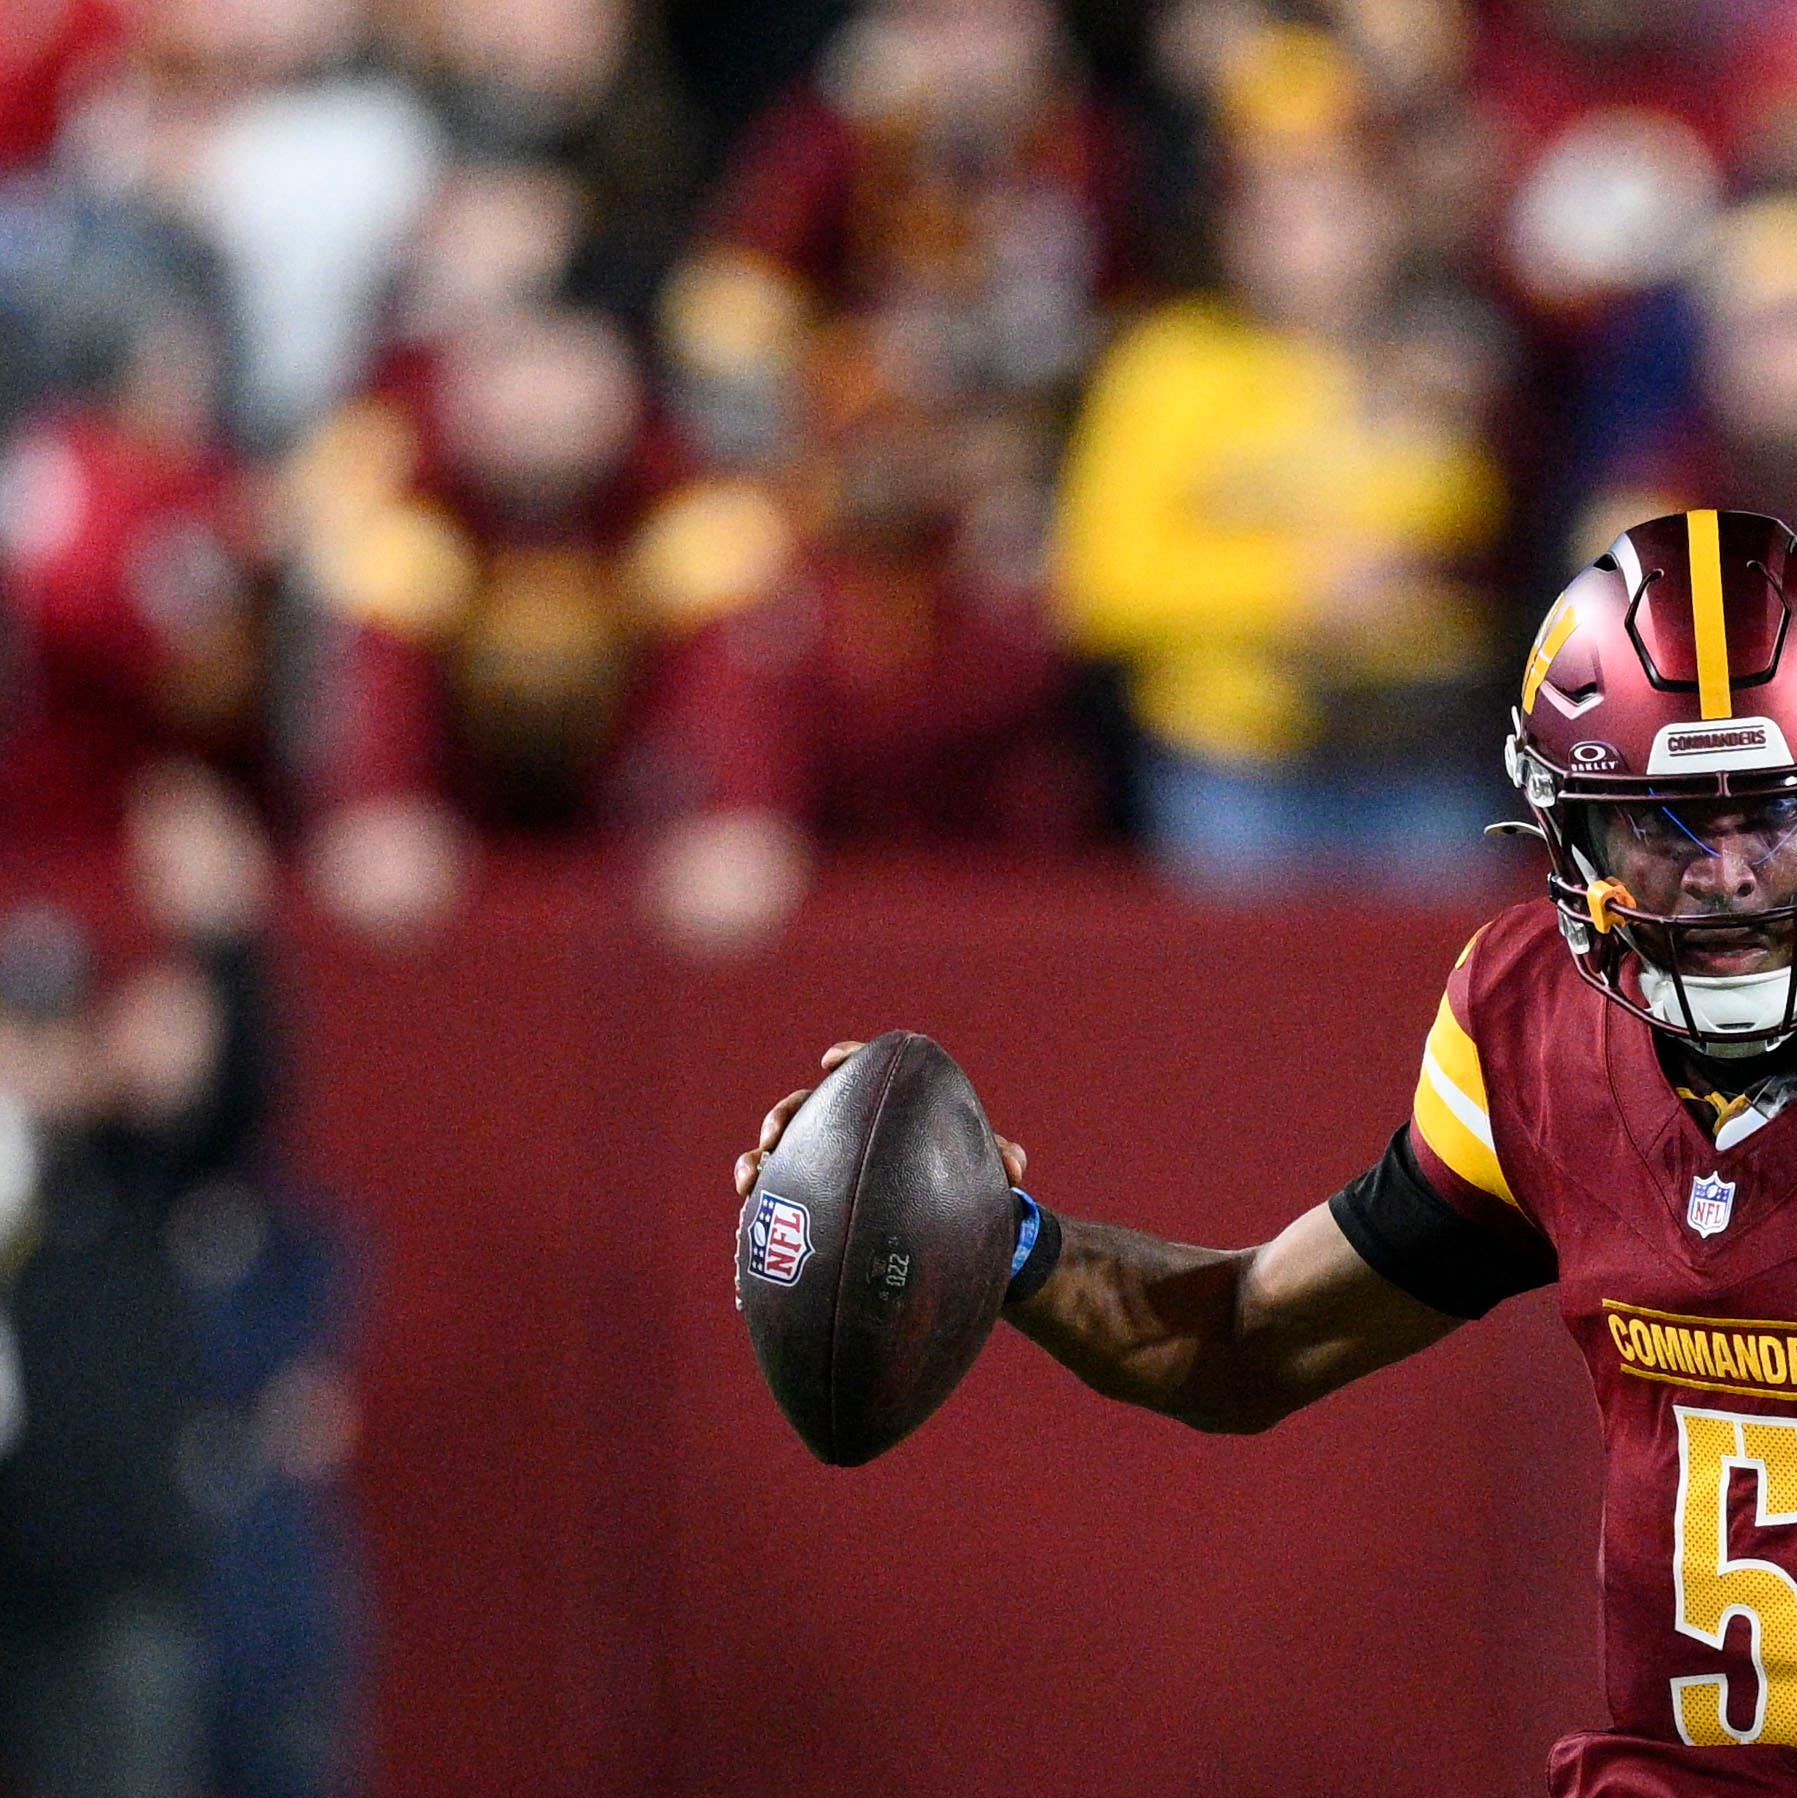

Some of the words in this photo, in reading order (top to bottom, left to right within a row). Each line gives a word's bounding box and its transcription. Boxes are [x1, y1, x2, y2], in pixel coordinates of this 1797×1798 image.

[1668, 730, 1766, 751] COMMANDERS
[1570, 760, 1617, 772] OAKLEY
[1694, 1201, 1723, 1225] NFL
[766, 1212, 801, 1277] NFL
